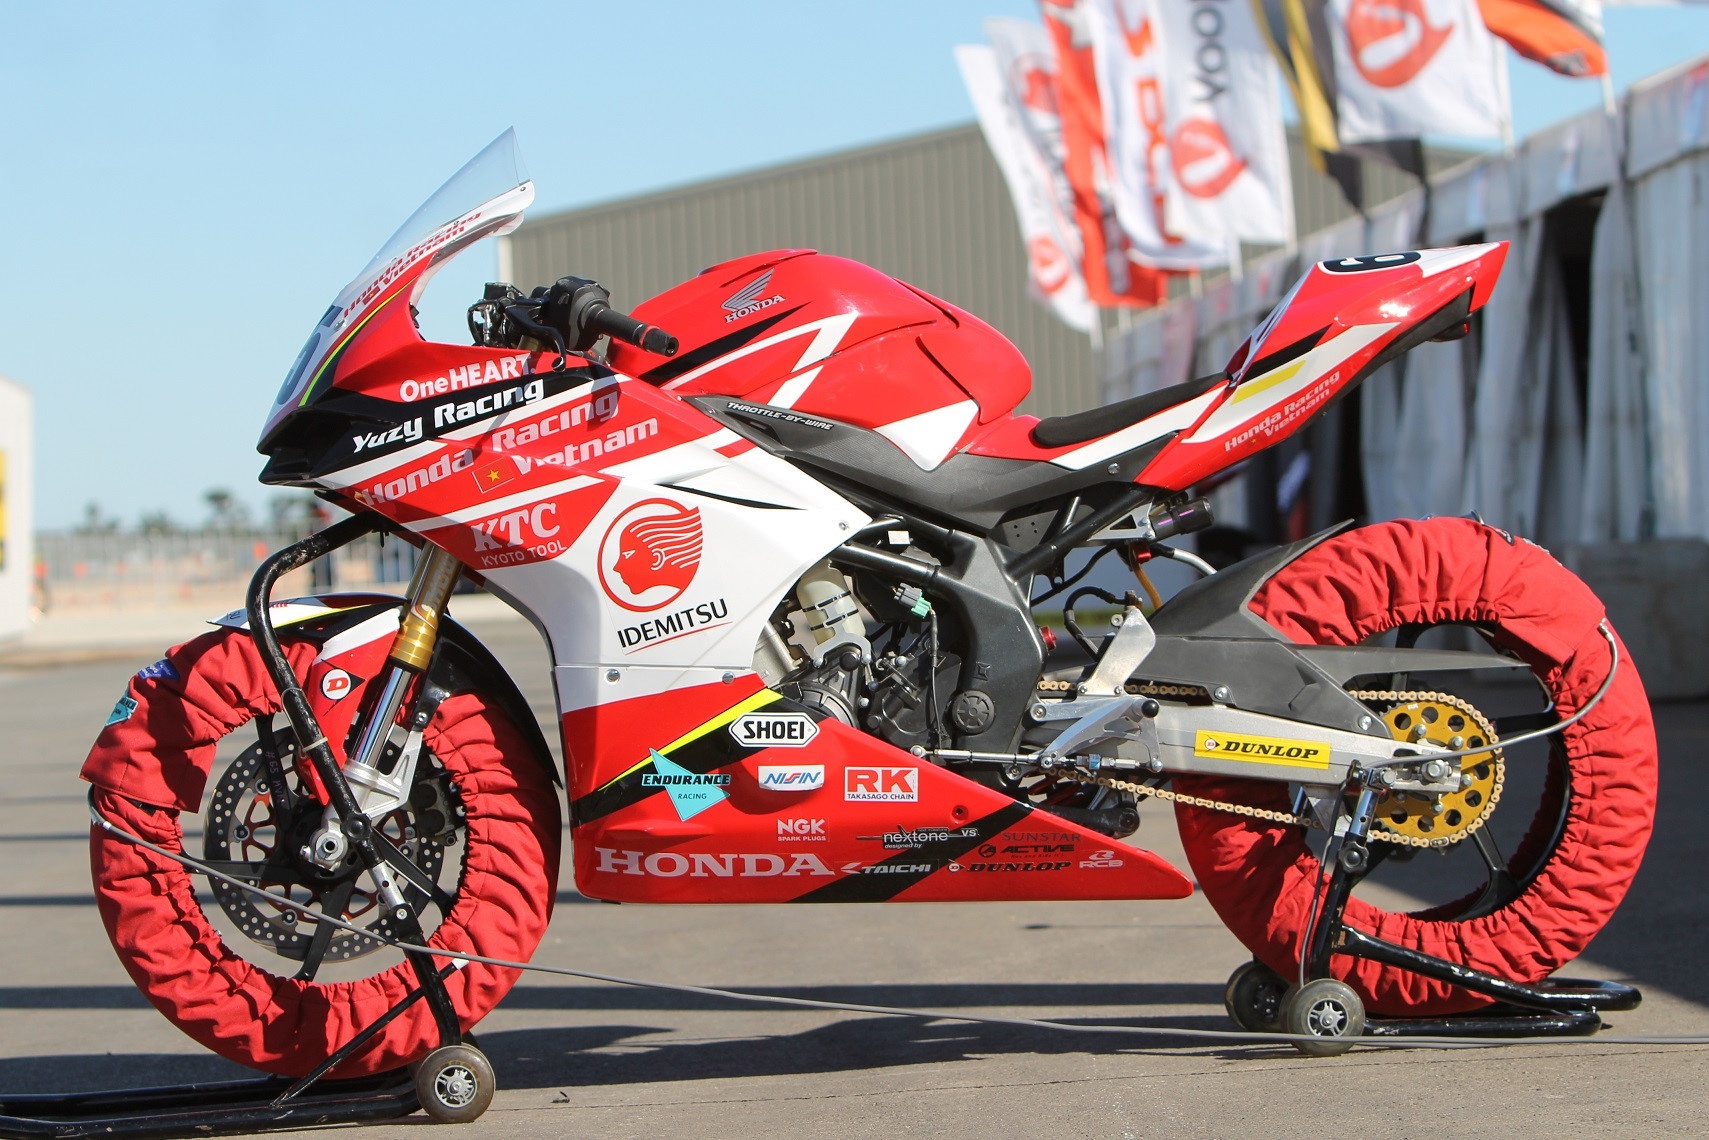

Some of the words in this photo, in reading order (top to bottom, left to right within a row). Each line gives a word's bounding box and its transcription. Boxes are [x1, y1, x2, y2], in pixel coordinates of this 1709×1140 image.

[383, 226, 465, 285] Vietnam
[343, 257, 403, 318] Honda
[725, 295, 786, 323] HONDA
[353, 417, 423, 453] Yuzy
[434, 379, 544, 428] Racing
[728, 402, 834, 431] THROTTLE-BY-WIRE
[1224, 411, 1282, 452] Honda
[1284, 371, 1341, 416] Racing
[1263, 388, 1330, 437] Vietnam
[361, 448, 475, 506] Honda
[492, 391, 619, 452] Racing
[471, 503, 560, 552] KTC
[481, 551, 525, 566] KYOTO
[527, 540, 567, 558] TOOL
[617, 598, 728, 648] IDEMITSU
[326, 677, 349, 692] D
[743, 721, 805, 740] SHOEI
[1222, 741, 1319, 759] DUNLOP
[642, 774, 731, 785] ENDURANCE
[847, 769, 914, 793] RK
[777, 818, 826, 835] NGK
[884, 827, 949, 843] nextone
[1002, 832, 1082, 842] SUNSTAR
[595, 846, 836, 877] HONDA
[1000, 844, 1075, 854] ACTIVE
[862, 864, 931, 874] TAICHI
[967, 862, 1072, 873] DUNLOP
[1079, 859, 1124, 869] RCB
